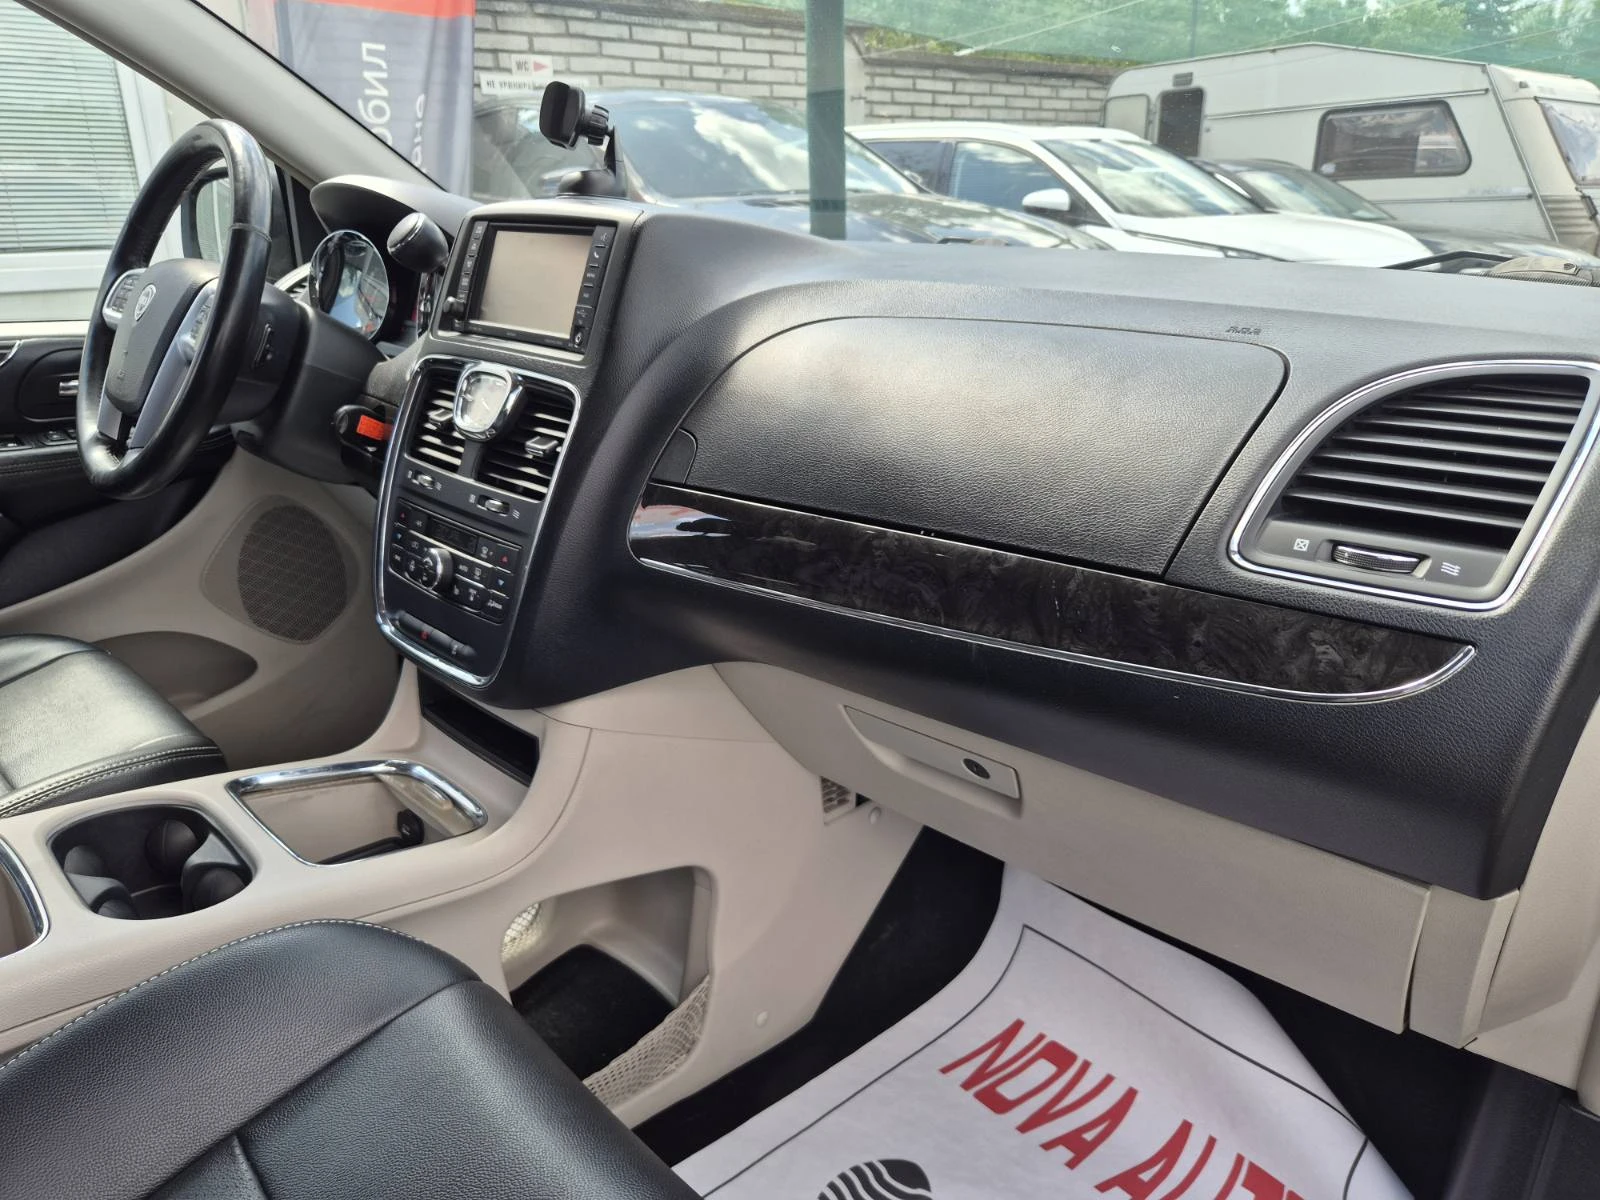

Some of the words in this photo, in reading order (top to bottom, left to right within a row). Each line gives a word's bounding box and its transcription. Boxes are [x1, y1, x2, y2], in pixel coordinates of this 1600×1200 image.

[515, 60, 529, 72] WC
[938, 1017, 1138, 1170] NOVA
[1093, 1118, 1307, 1200] AU
